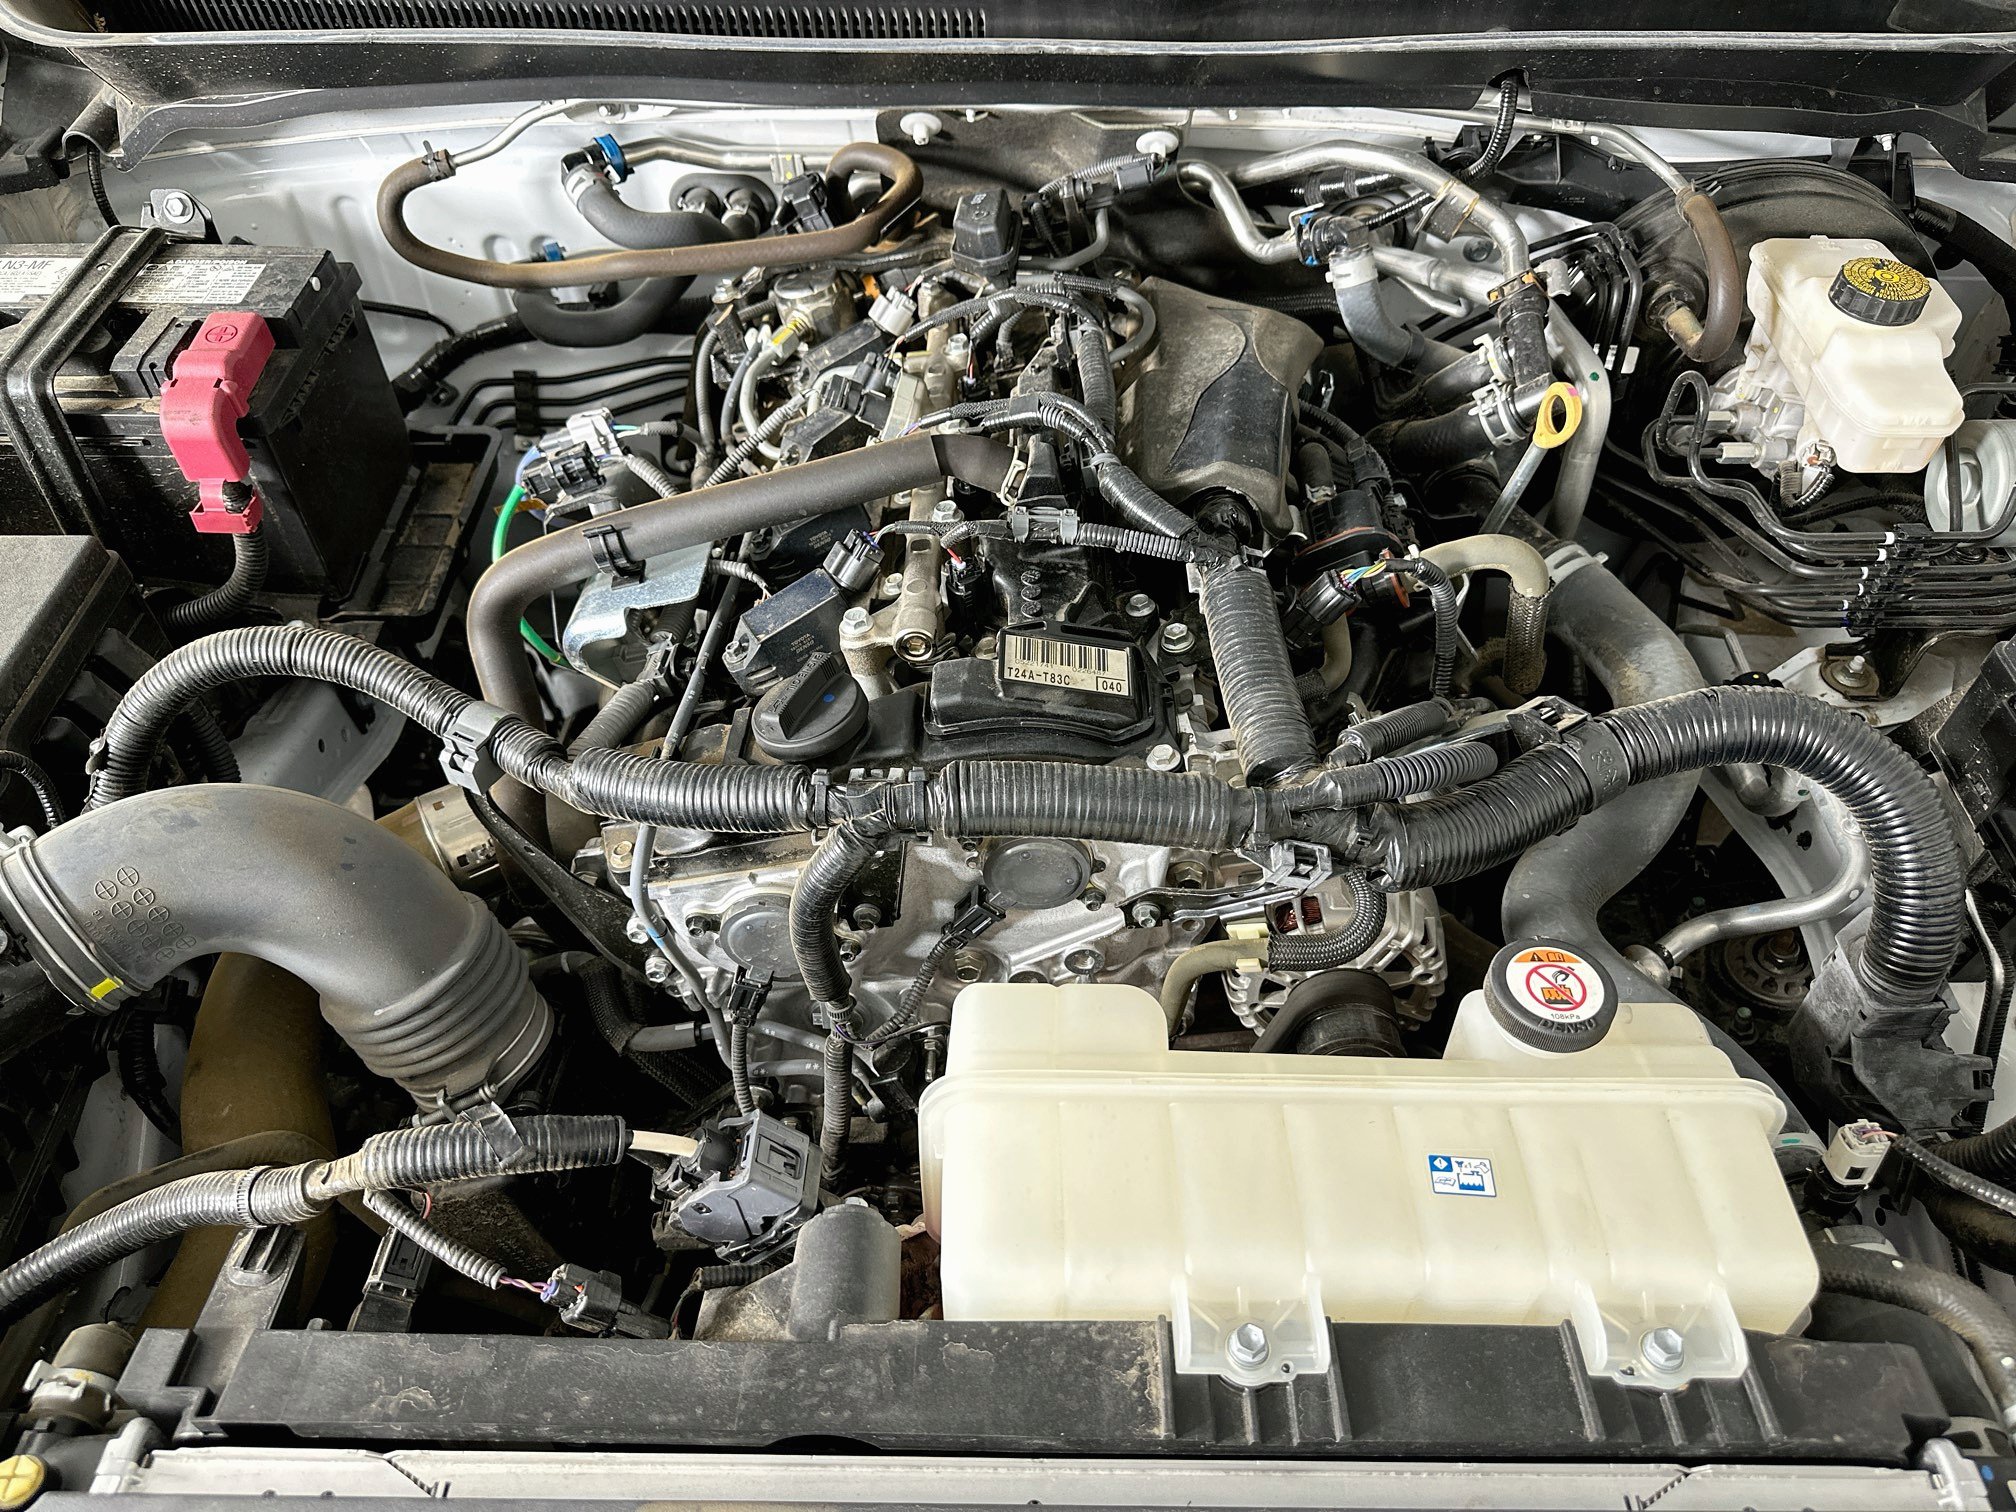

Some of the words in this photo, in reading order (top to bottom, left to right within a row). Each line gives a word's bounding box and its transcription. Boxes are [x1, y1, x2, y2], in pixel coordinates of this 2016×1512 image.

[0, 260, 55, 270] N3-MF
[790, 633, 811, 646] TOYOTA
[795, 640, 815, 654] DENSO
[1007, 666, 1071, 686] T24A-T83C
[1102, 680, 1122, 693] 040
[1550, 1012, 1581, 1020] 108kPa
[1538, 1018, 1597, 1034] DENSO
